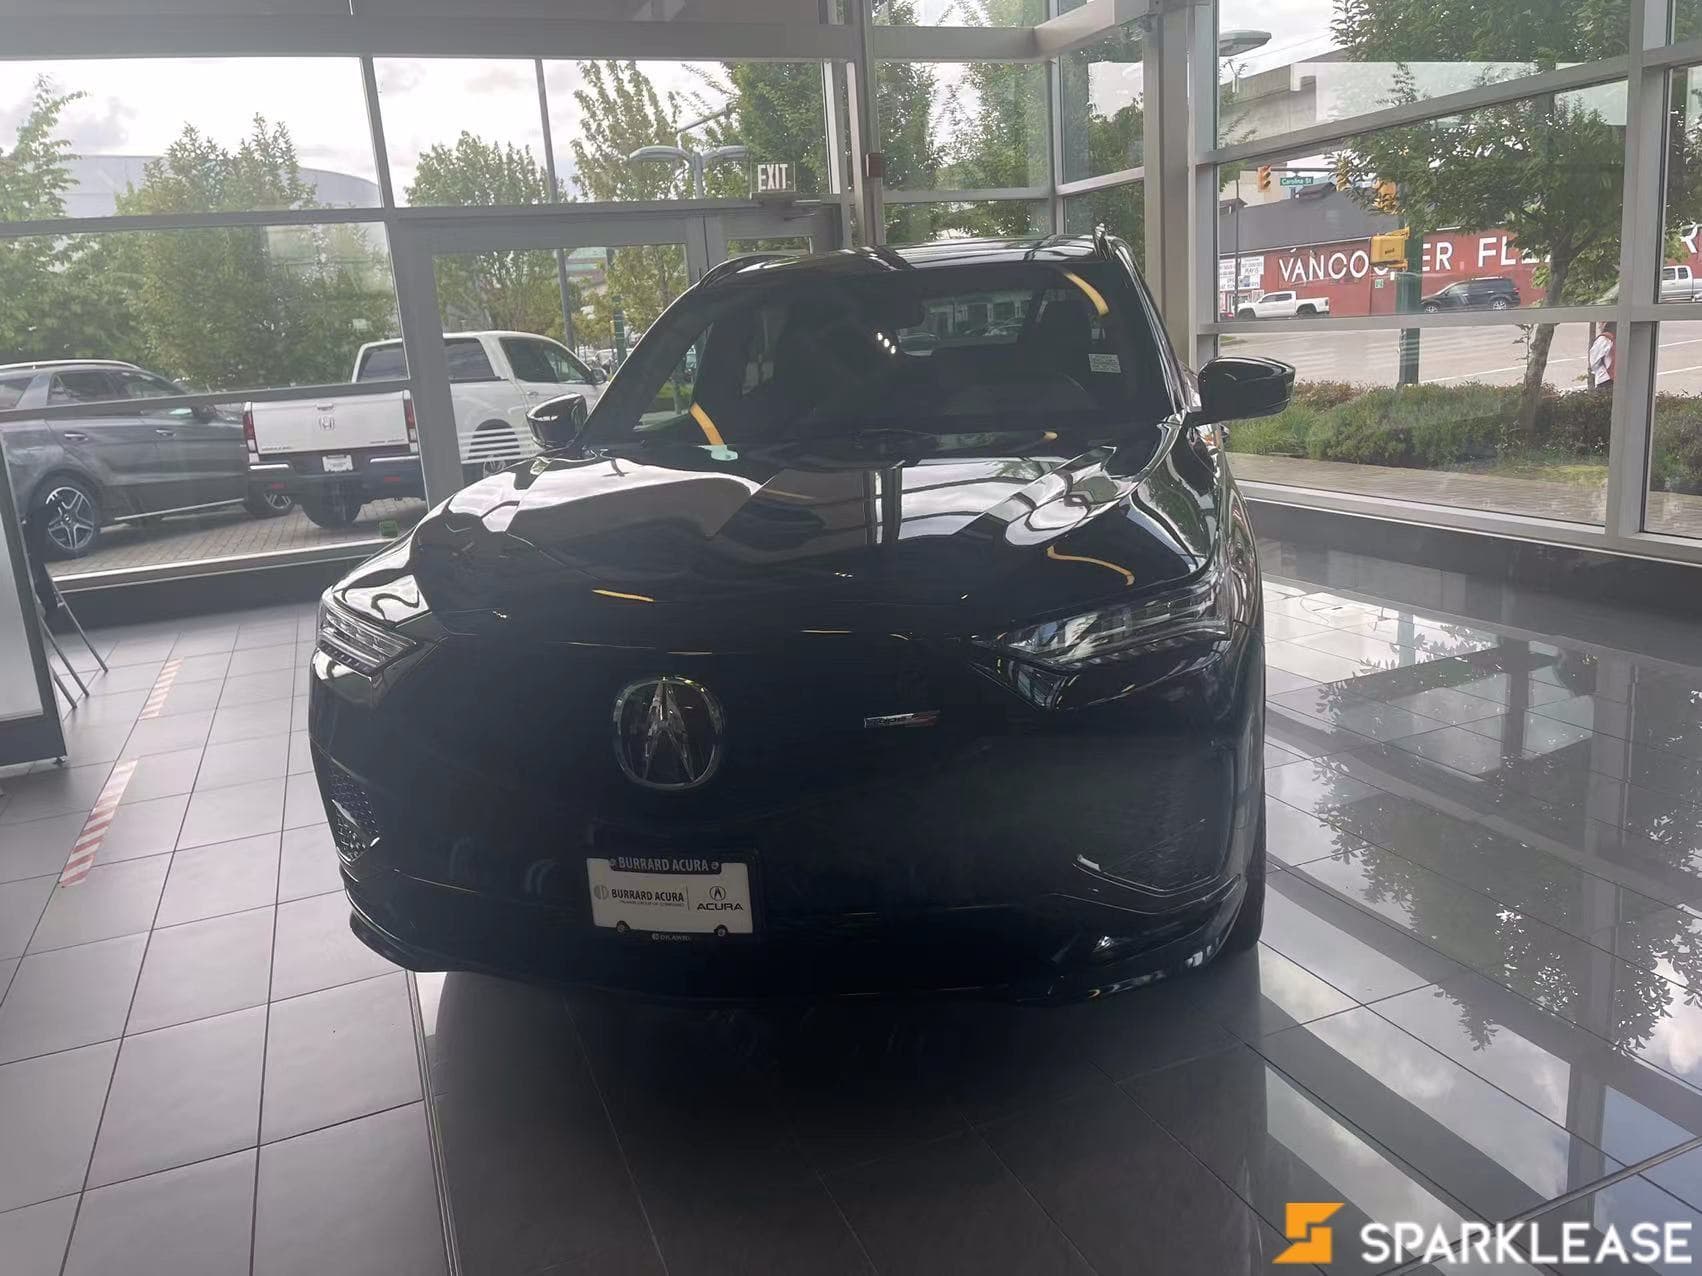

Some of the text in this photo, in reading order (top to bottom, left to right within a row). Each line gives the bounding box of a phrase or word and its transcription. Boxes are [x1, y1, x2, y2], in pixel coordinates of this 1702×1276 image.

[758, 164, 788, 190] EXIT
[1278, 241, 1453, 283] VANCOER
[1478, 235, 1551, 268] FL
[618, 857, 709, 872] BURRARD ACURA
[611, 888, 685, 902] BURRARD ACURA
[696, 902, 744, 911] ACURA
